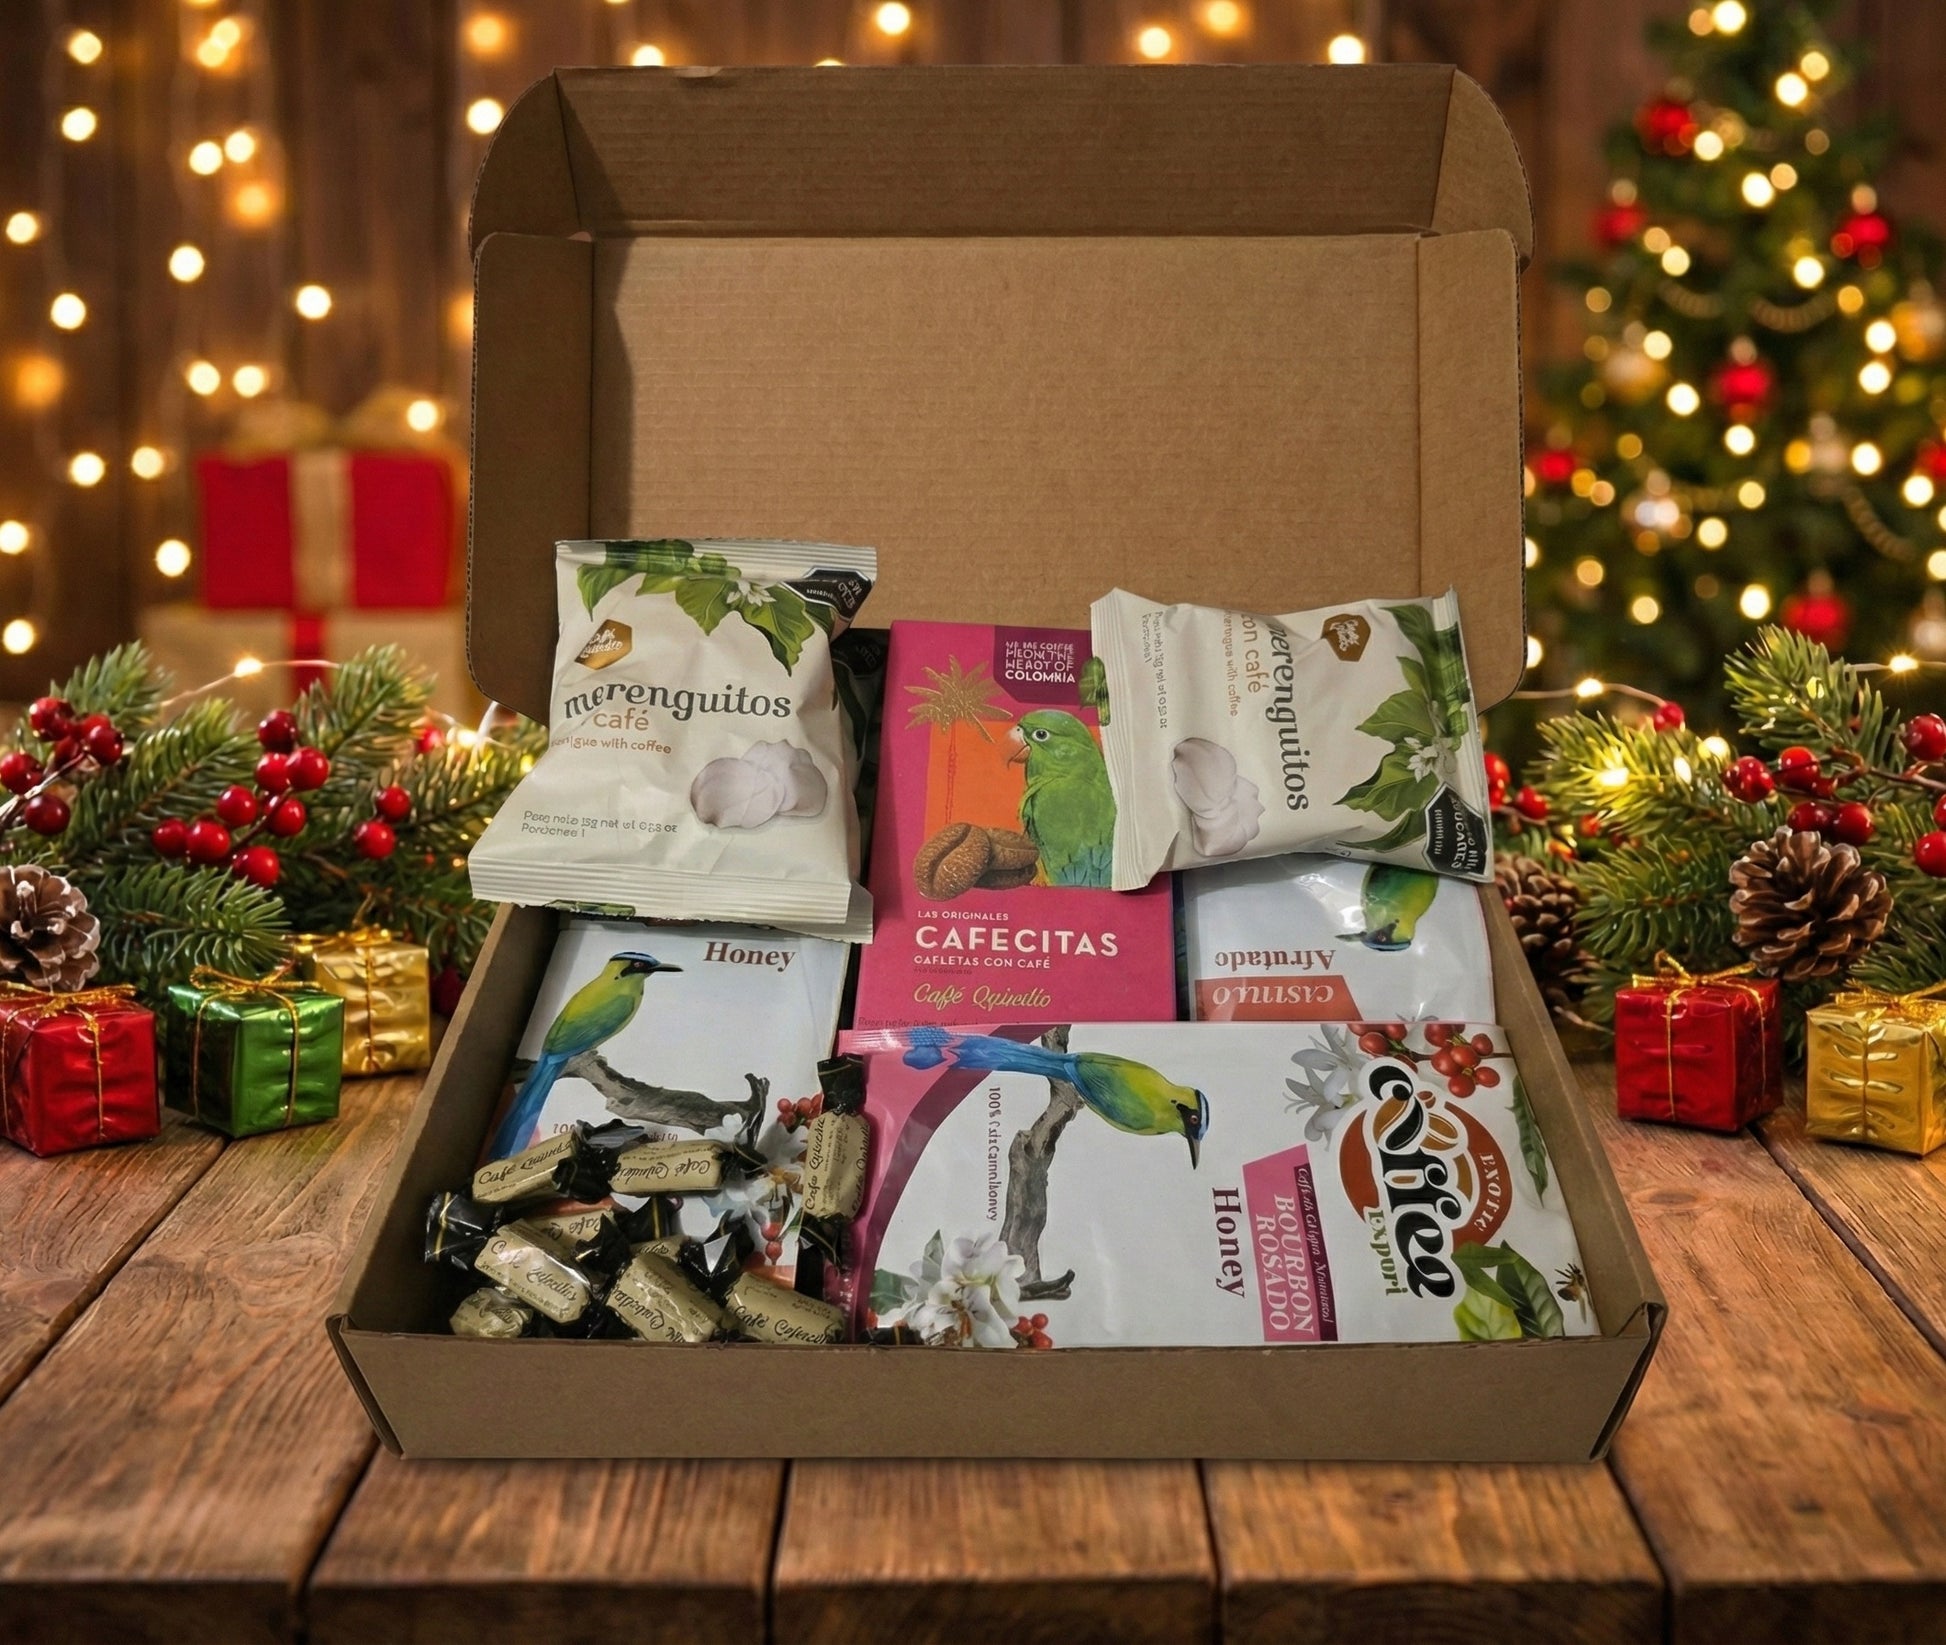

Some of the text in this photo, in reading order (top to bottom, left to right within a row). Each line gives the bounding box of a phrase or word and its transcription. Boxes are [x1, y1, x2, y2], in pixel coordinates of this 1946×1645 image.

[563, 682, 792, 722] merenguitos
[600, 735, 629, 750] with
[917, 910, 1010, 922] LAS ORIGINALES
[702, 940, 797, 973] Honey
[914, 924, 1120, 958] CAFECITAS
[983, 955, 1014, 969] CON
[1213, 949, 1338, 972] Afrutado
[1210, 1186, 1246, 1299] Honey
[1254, 1213, 1292, 1332] ROSADO
[1273, 1193, 1316, 1337] BOURBON
